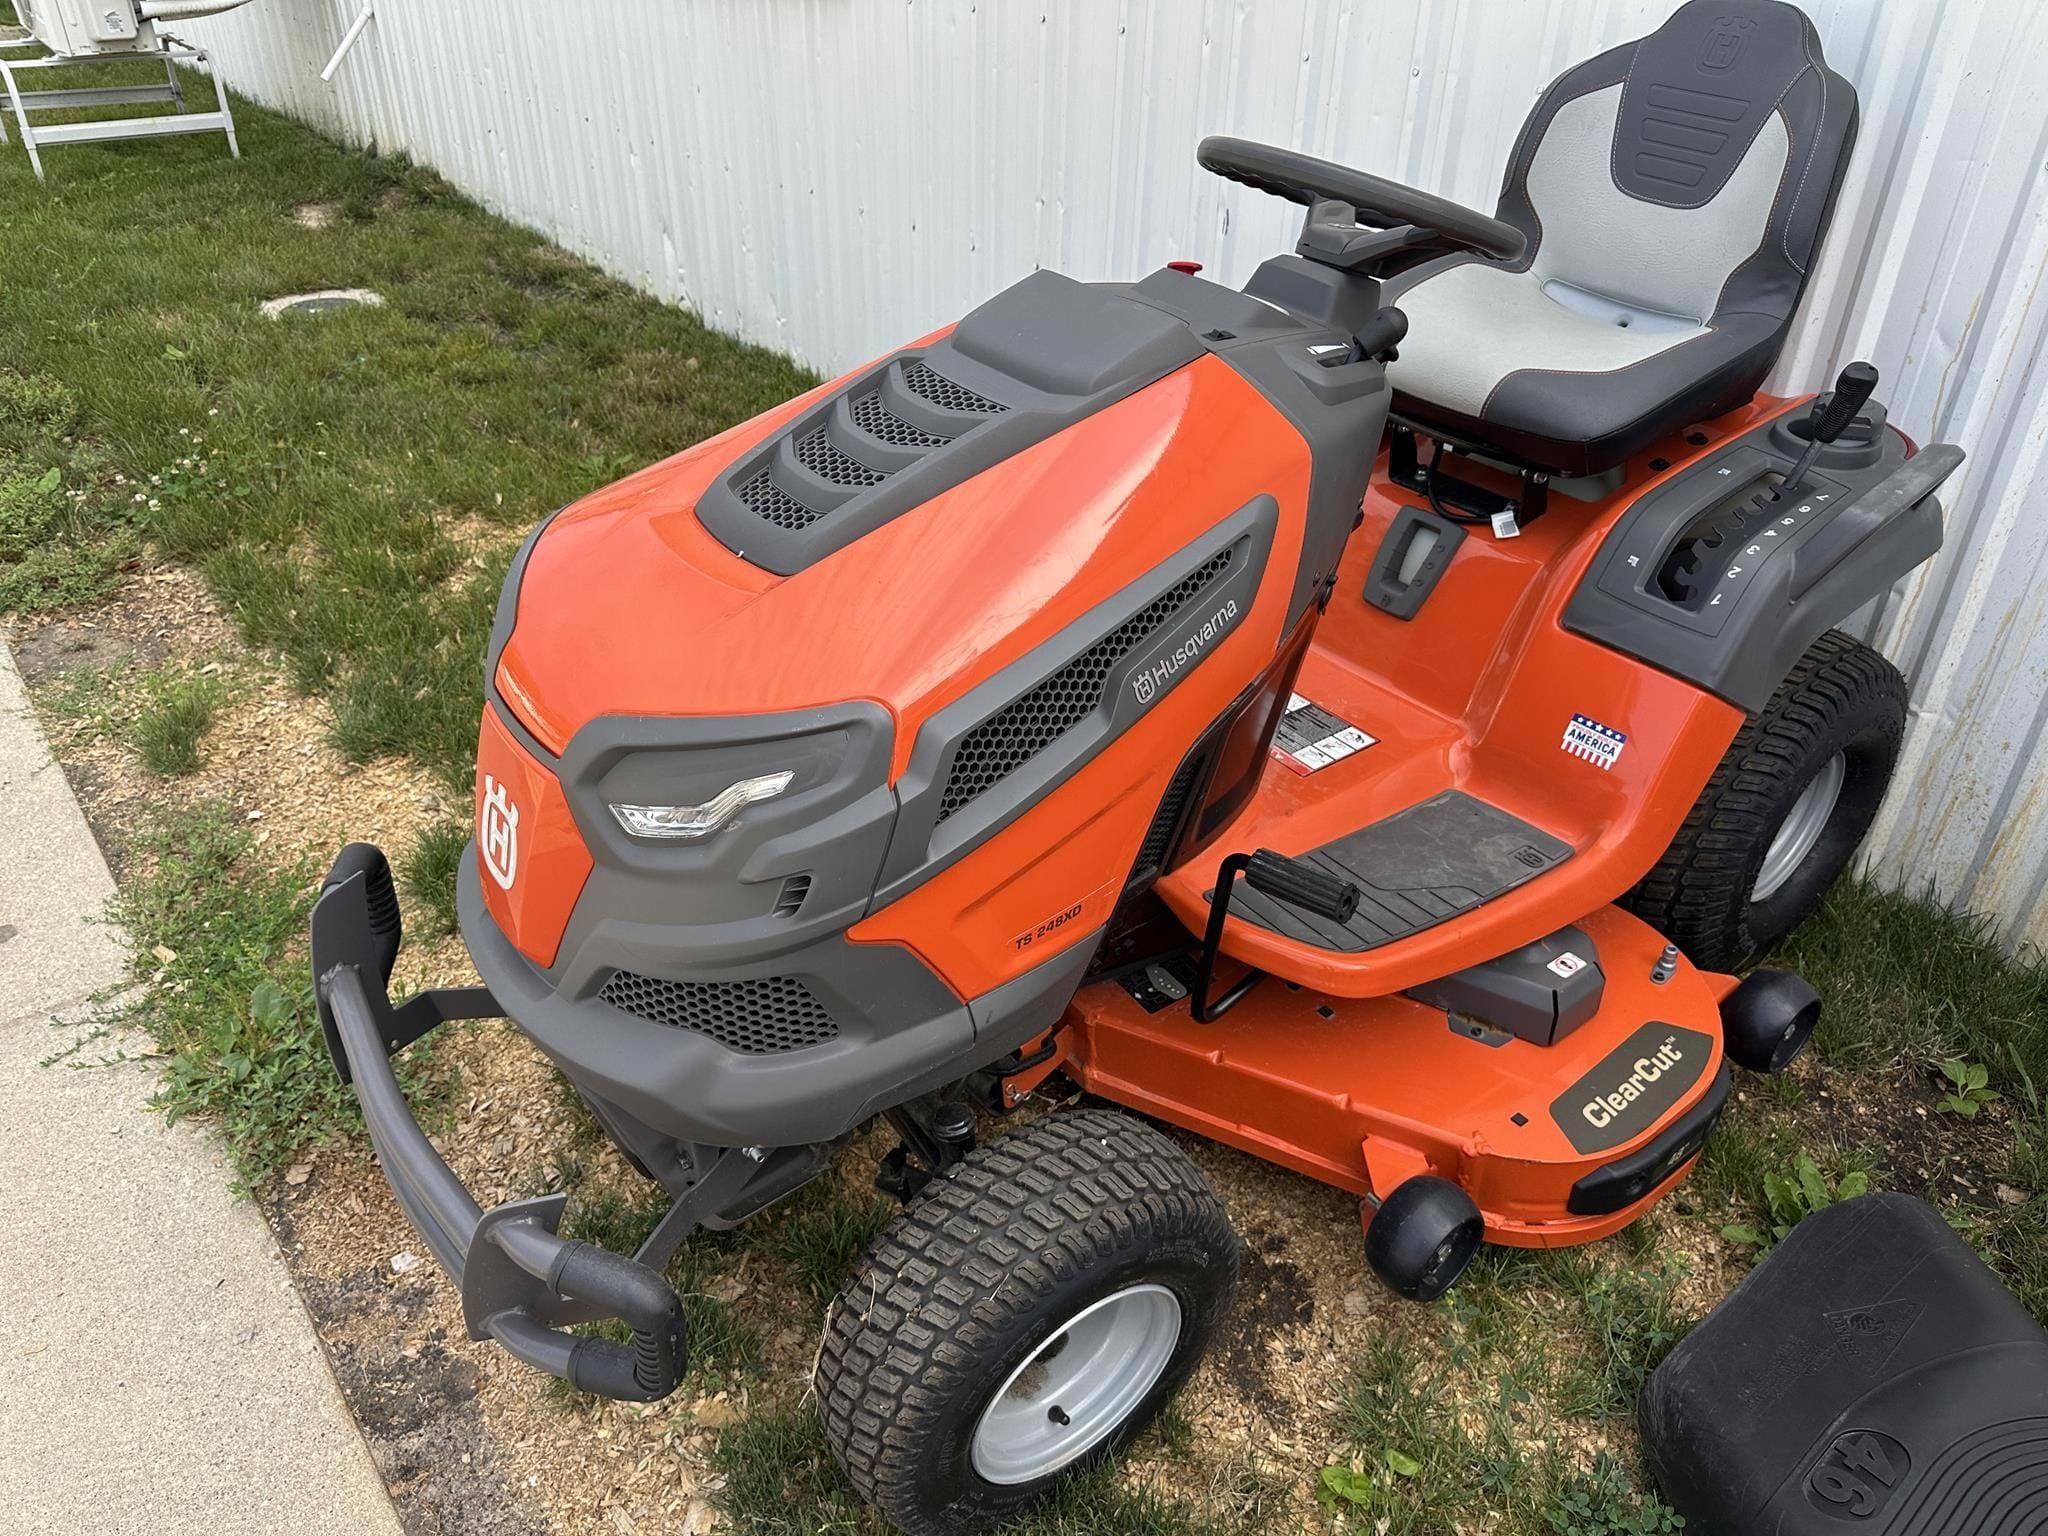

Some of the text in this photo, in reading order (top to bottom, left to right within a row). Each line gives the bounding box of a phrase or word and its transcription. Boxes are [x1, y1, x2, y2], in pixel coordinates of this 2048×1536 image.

[1798, 505, 1811, 513] 6
[1780, 517, 1795, 526] 5
[1763, 529, 1778, 538] 4
[1745, 544, 1761, 556] 3
[1727, 565, 1743, 579] 2
[1709, 593, 1723, 606] 1
[1151, 598, 1239, 688] Husqvarna
[1567, 728, 1617, 758] AMERICA
[1015, 903, 1083, 950] TS 248XD
[1809, 1433, 1897, 1517] 46
